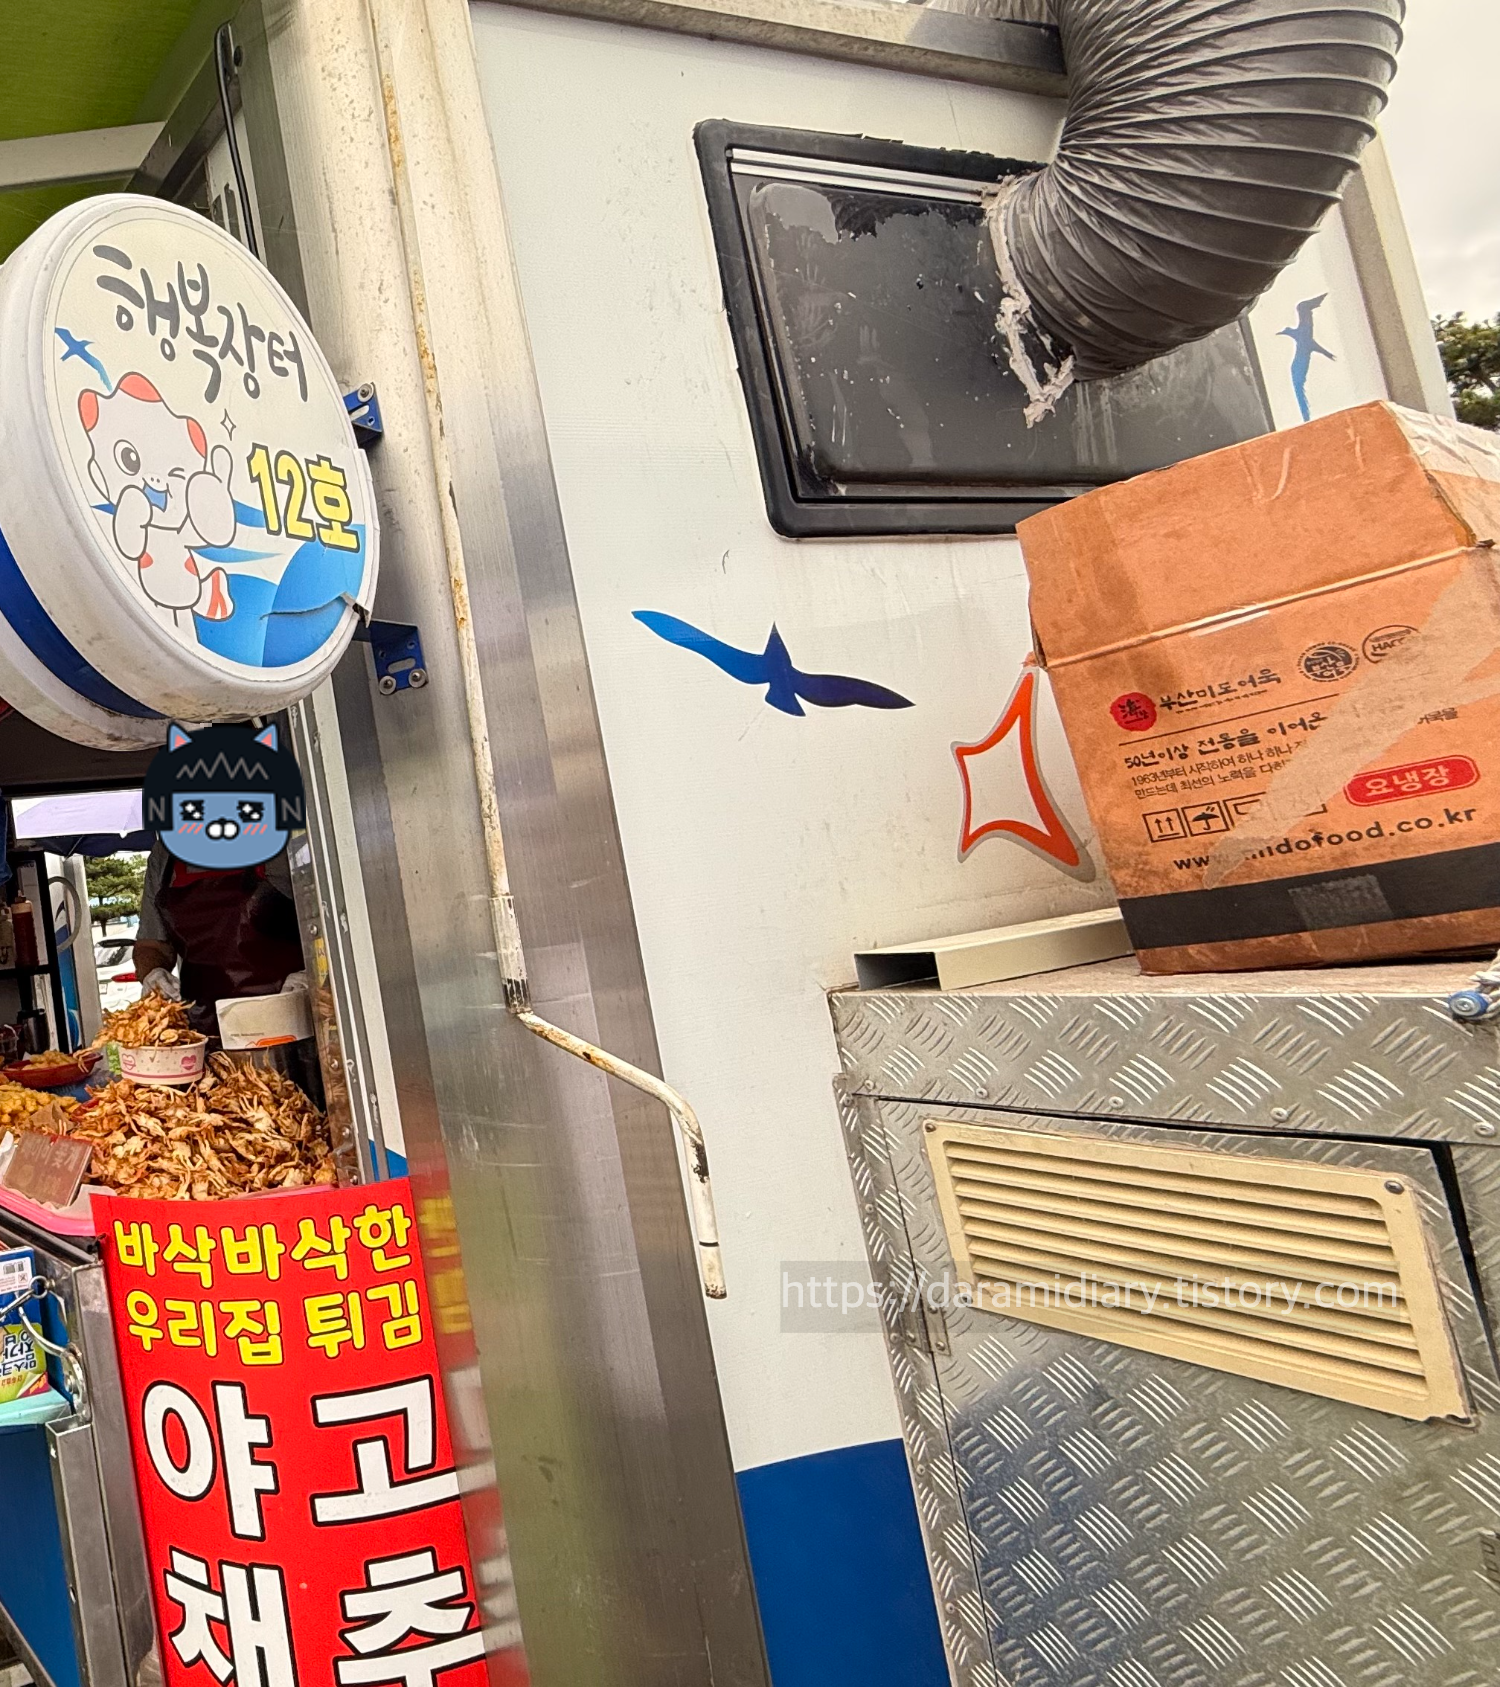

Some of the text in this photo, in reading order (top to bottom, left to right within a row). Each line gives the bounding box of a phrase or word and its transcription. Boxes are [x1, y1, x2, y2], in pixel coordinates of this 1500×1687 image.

[92, 244, 308, 403] 행복장터
[246, 442, 361, 553] 12호
[1124, 744, 1190, 769] 50년이상
[1266, 712, 1329, 736] 이어온
[1131, 766, 1187, 786] 1963년부터
[1189, 755, 1236, 776] 시작하여
[1238, 750, 1264, 764] 하나
[1180, 775, 1216, 791] 최선의
[1259, 759, 1292, 774] 다하
[1364, 764, 1450, 797] 요냉장
[113, 1203, 411, 1288] 바삭바삭한
[126, 1279, 422, 1365] 우리집 튀김
